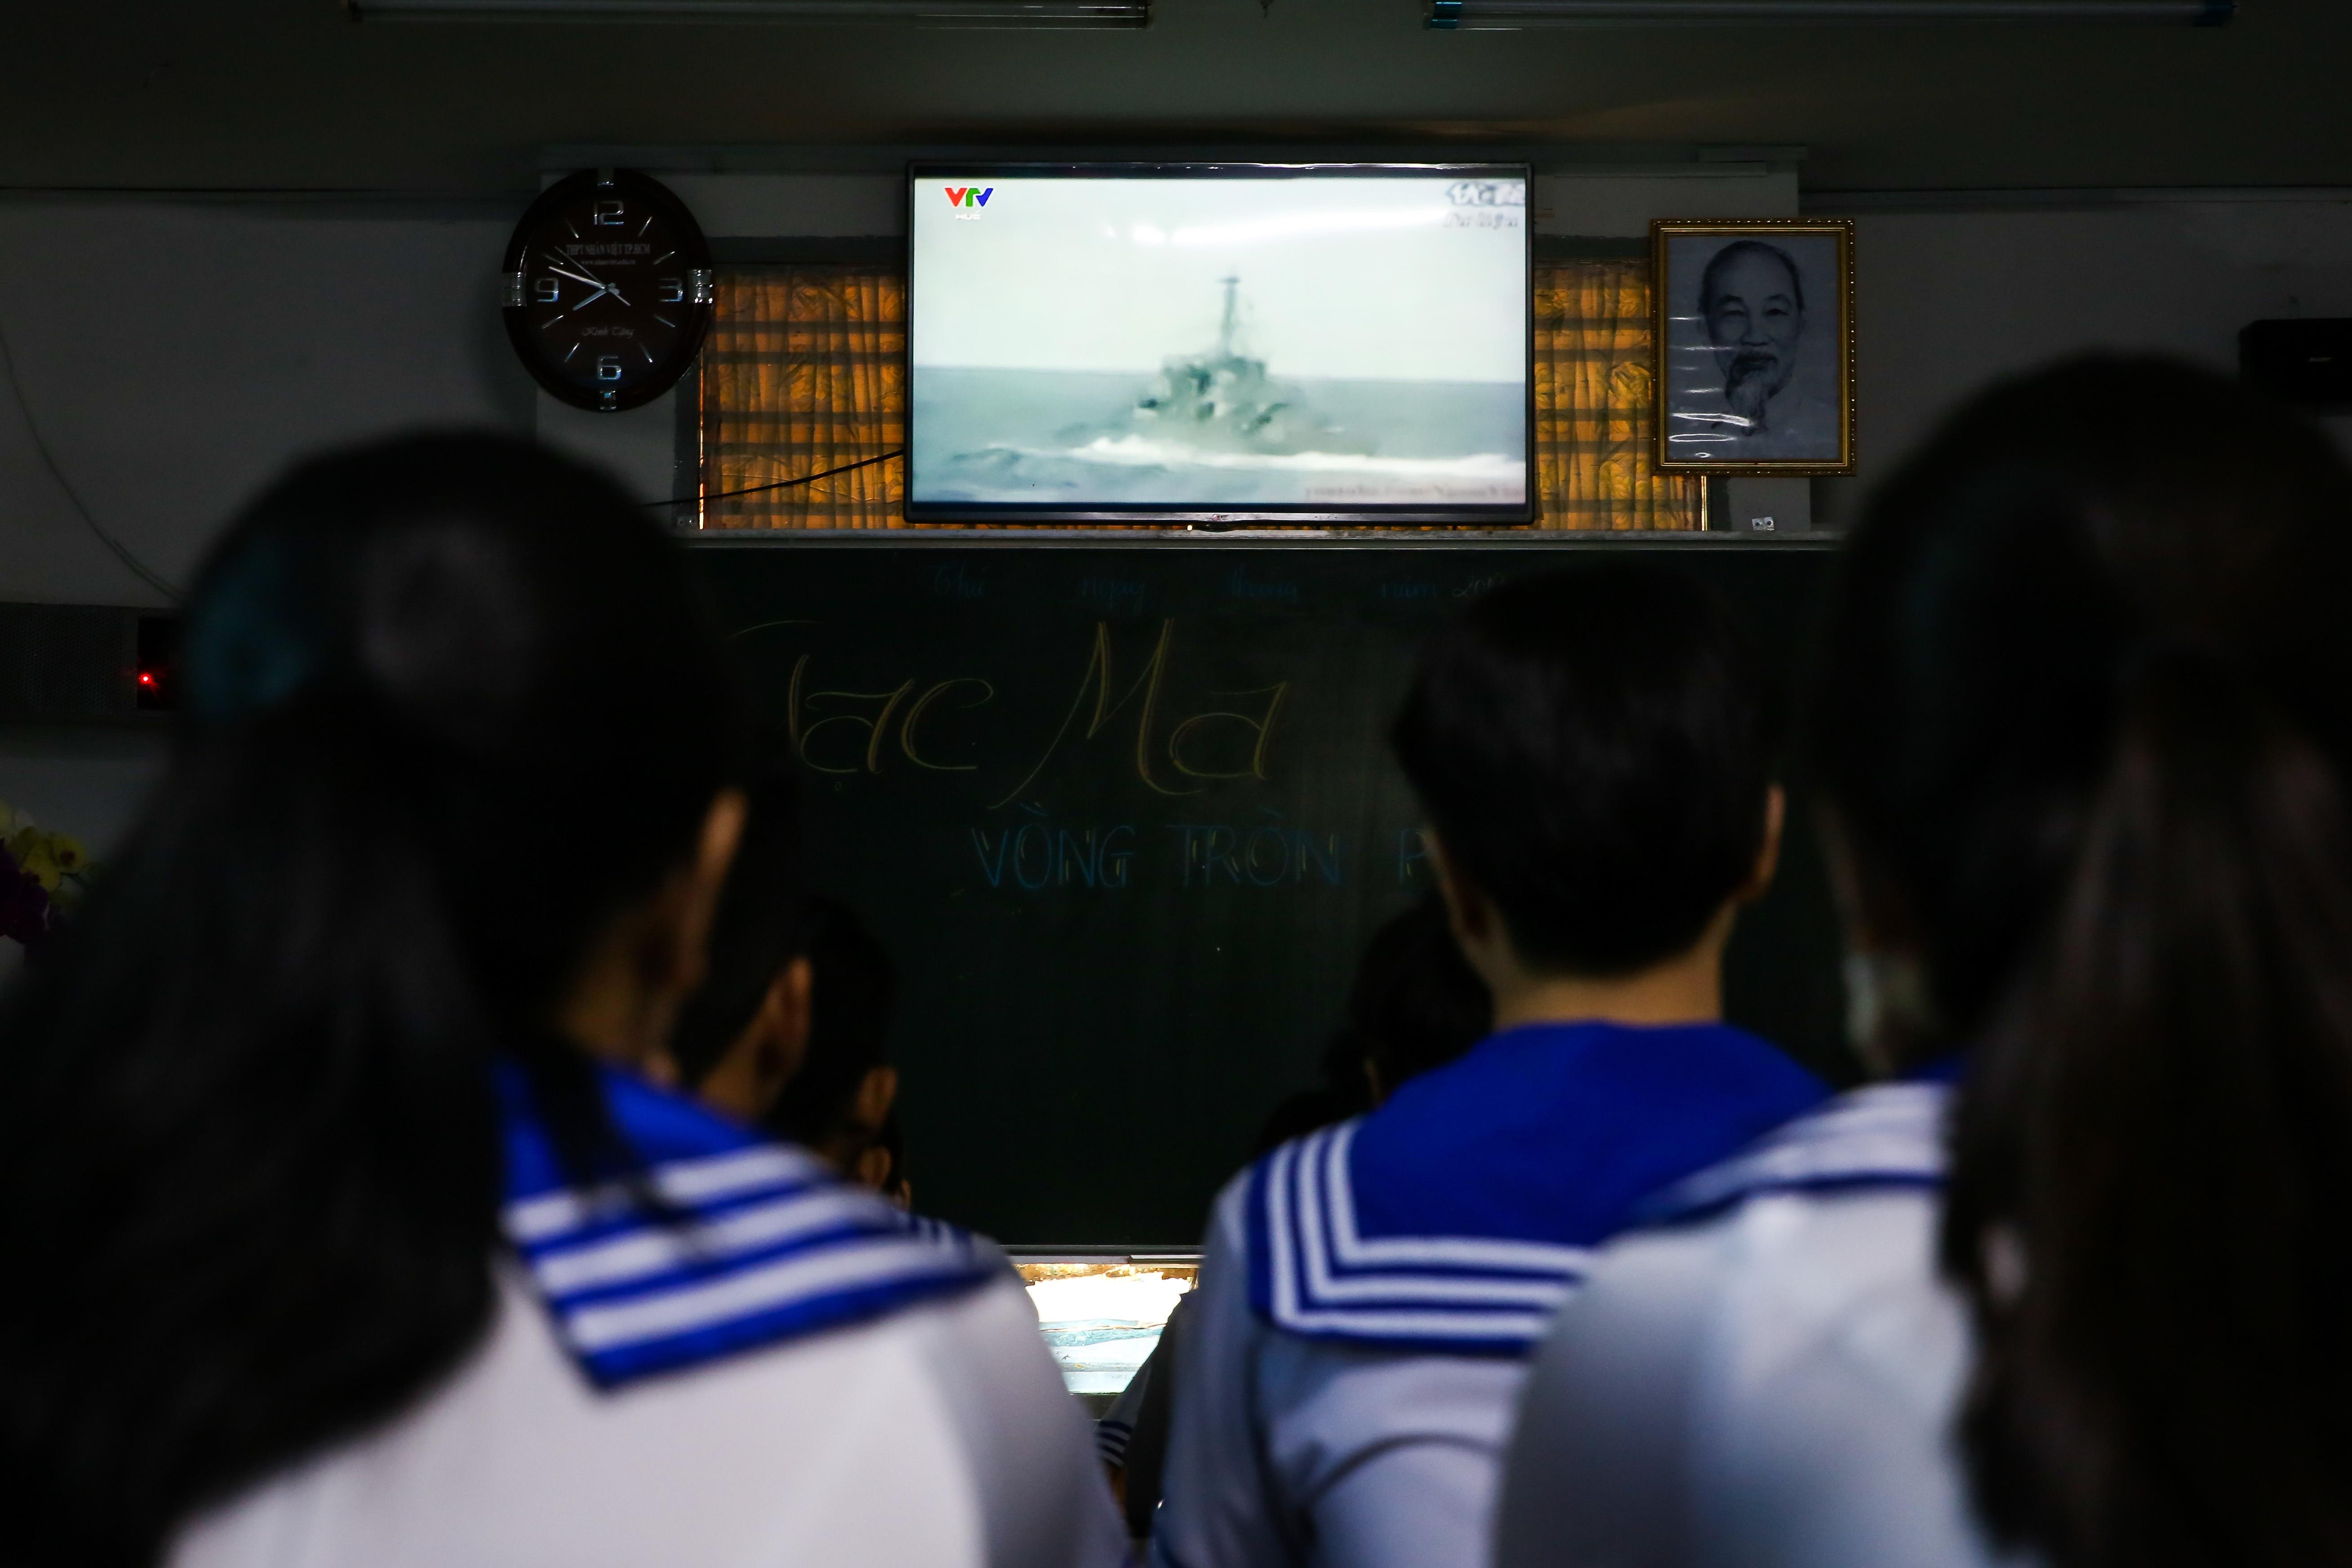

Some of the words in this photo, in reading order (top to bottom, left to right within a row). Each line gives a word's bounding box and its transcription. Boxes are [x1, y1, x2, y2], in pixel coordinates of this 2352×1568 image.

[944, 187, 994, 207] VTV
[593, 200, 624, 225] 12
[534, 277, 560, 302] 9
[658, 277, 684, 302] 3
[597, 355, 622, 380] 6
